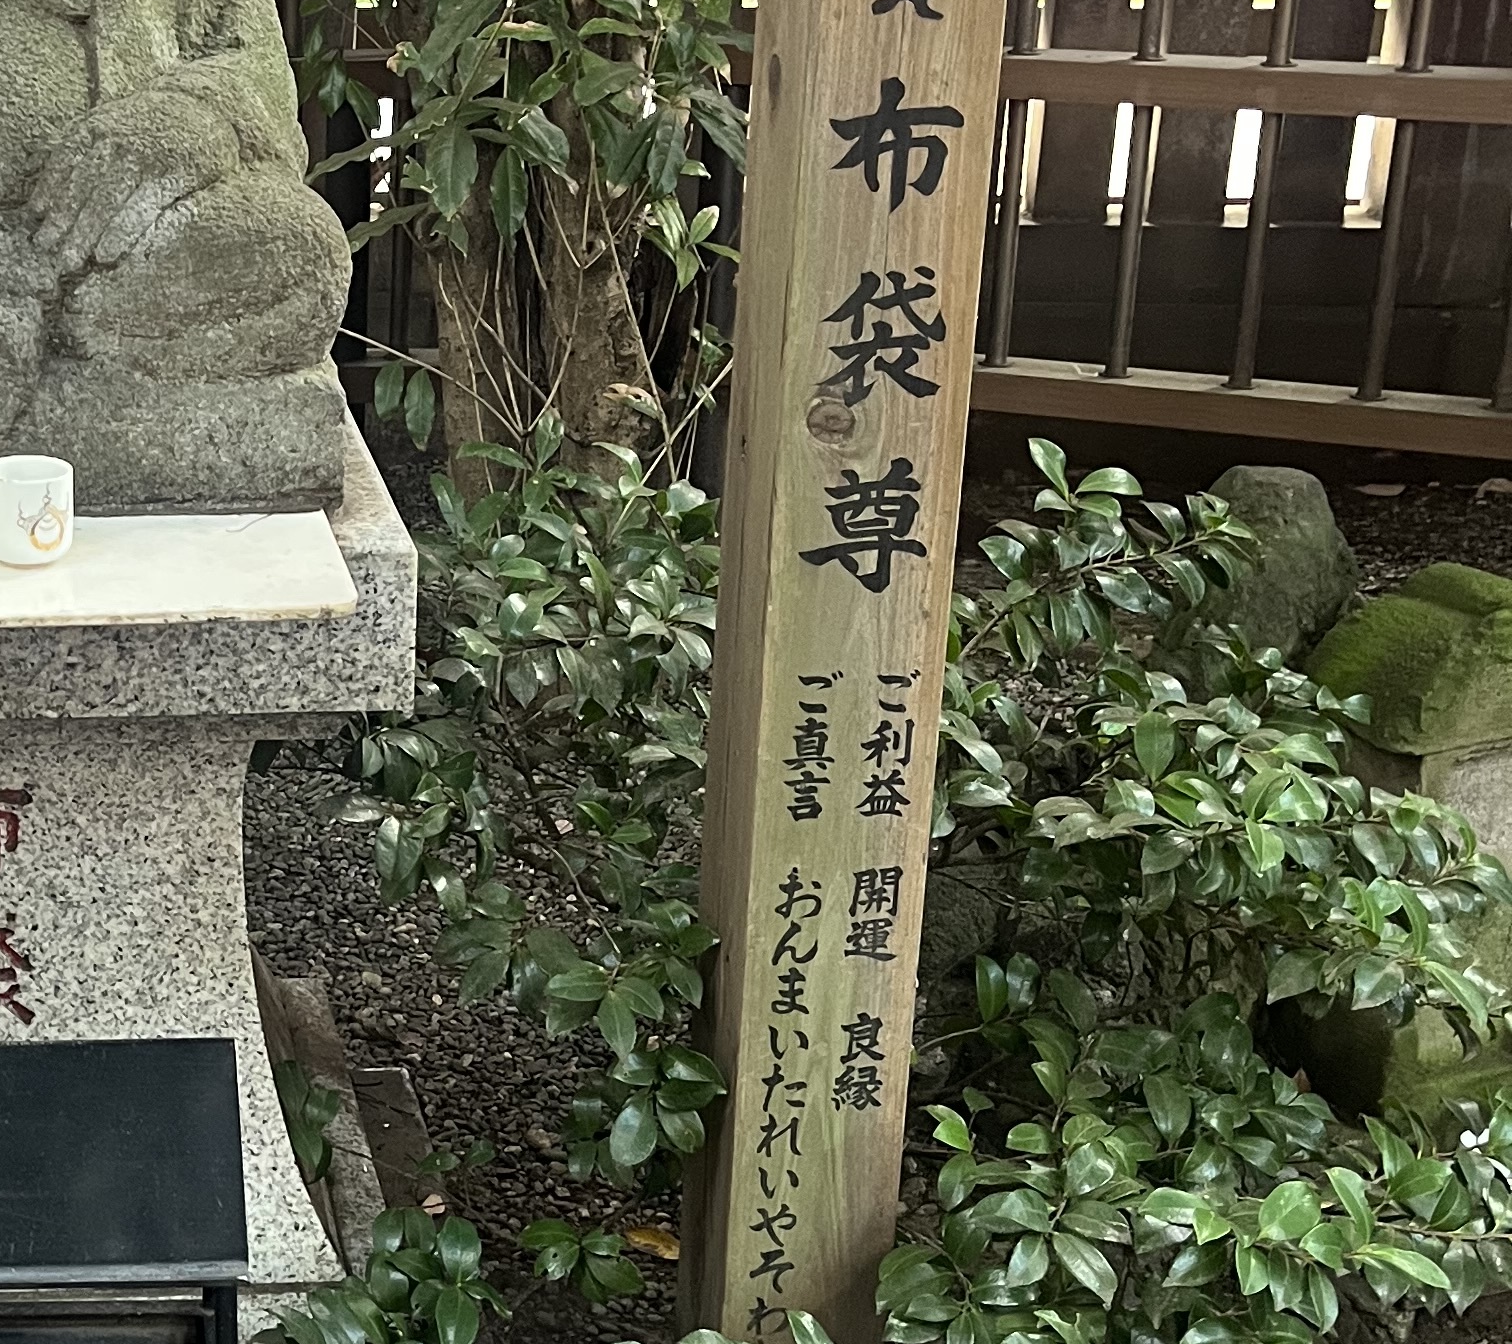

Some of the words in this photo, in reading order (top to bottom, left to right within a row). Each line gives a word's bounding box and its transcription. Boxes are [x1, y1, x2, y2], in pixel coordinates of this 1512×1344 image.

[798, 76, 965, 594] 布袋尊
[783, 669, 842, 824] ご真言
[852, 669, 921, 818] ご利益
[842, 865, 903, 962] 開運
[831, 1012, 886, 1112] 良縁
